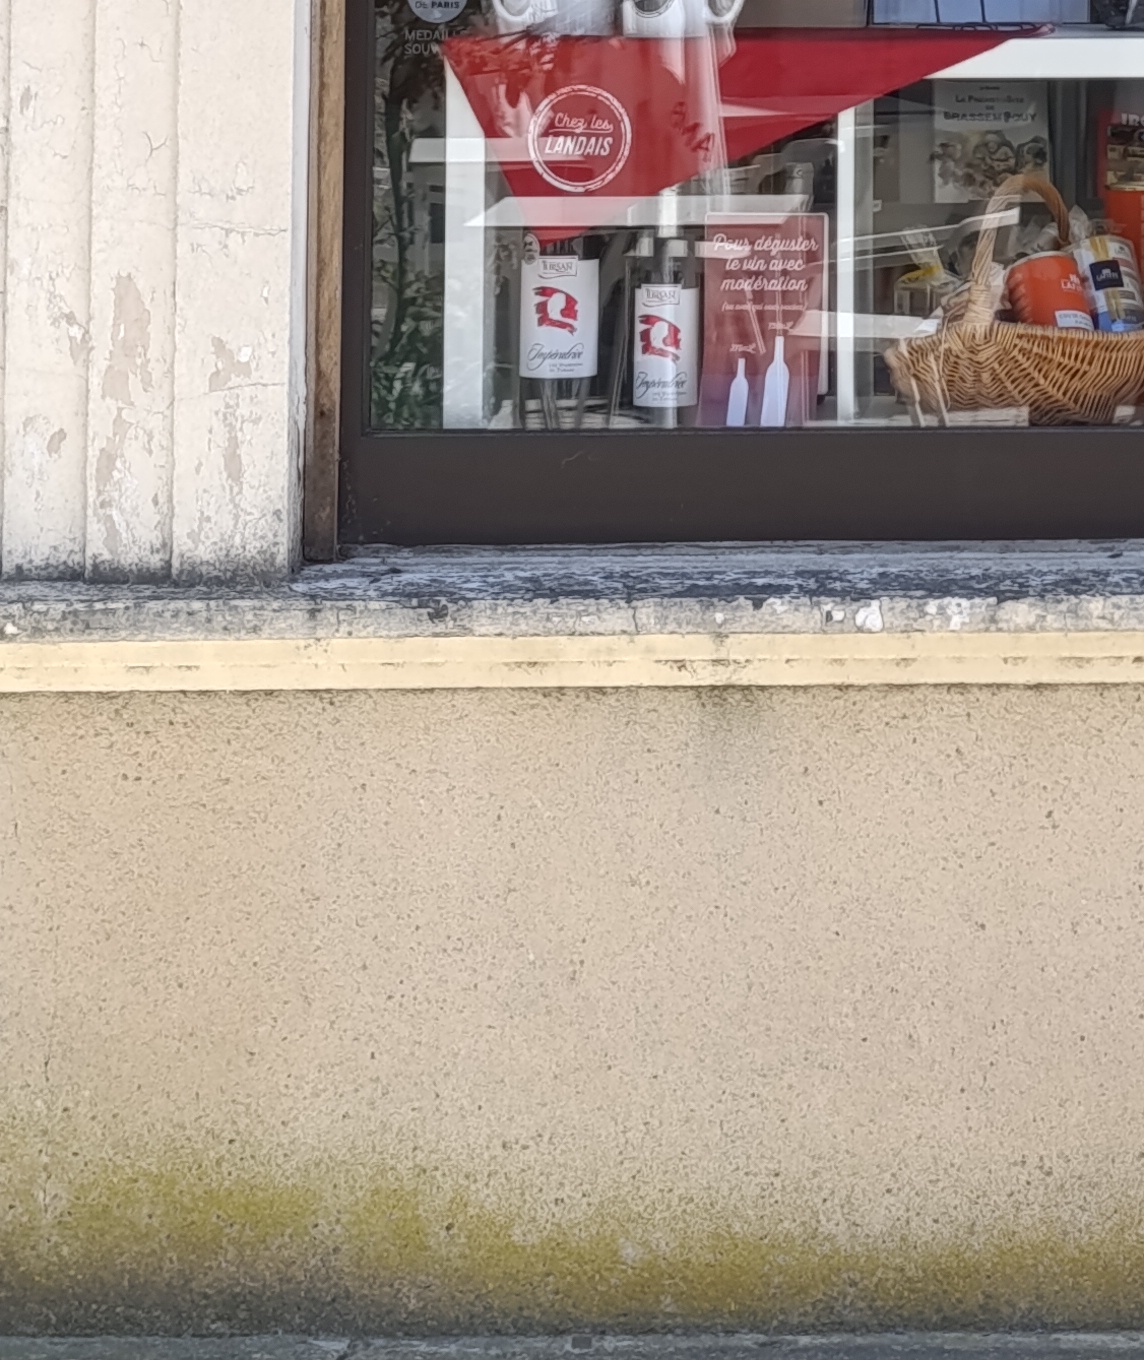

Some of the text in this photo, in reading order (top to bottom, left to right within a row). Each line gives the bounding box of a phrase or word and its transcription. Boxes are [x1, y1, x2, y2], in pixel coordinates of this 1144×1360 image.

[431, 0, 460, 10] PARIS
[553, 112, 615, 132] Chez les
[544, 135, 614, 157] LANDAIS
[753, 233, 820, 257] déguster
[725, 254, 807, 272] le vin avec
[720, 275, 809, 292] modération
